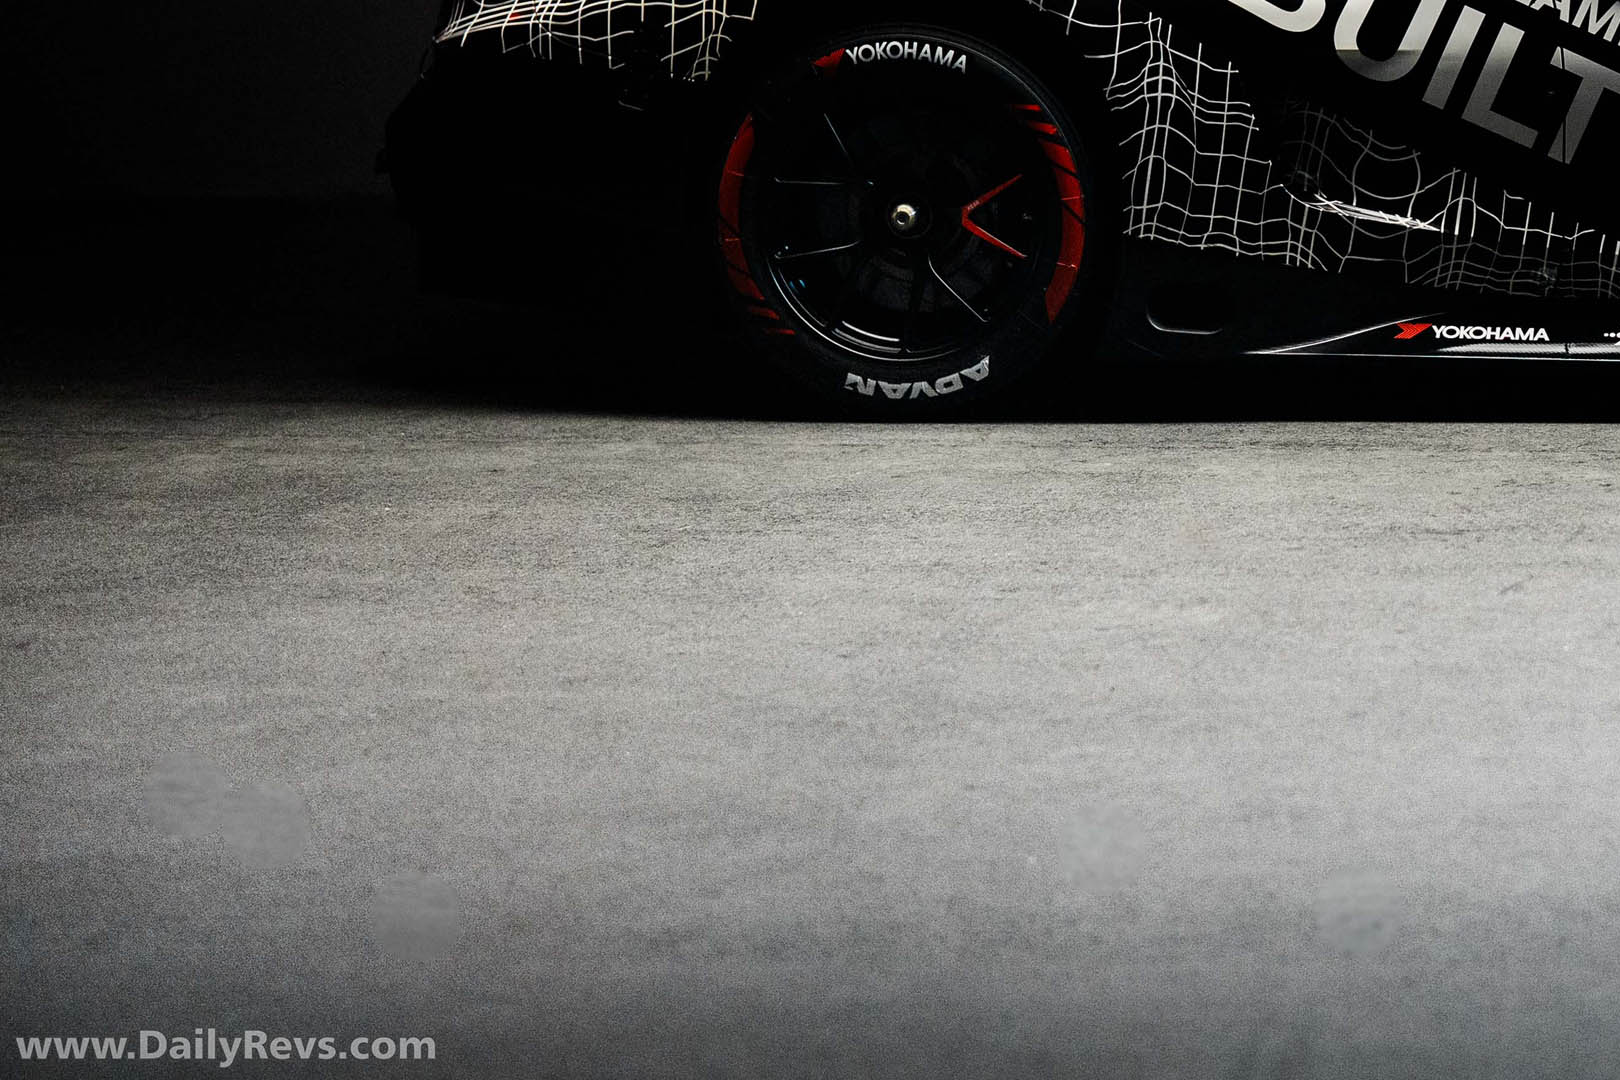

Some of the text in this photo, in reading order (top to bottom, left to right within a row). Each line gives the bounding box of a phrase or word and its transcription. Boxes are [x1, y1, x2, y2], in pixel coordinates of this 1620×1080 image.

[845, 40, 967, 74] YOKOHAMA
[1432, 324, 1550, 342] YOKOHAMA
[844, 355, 990, 400] ADVAN
